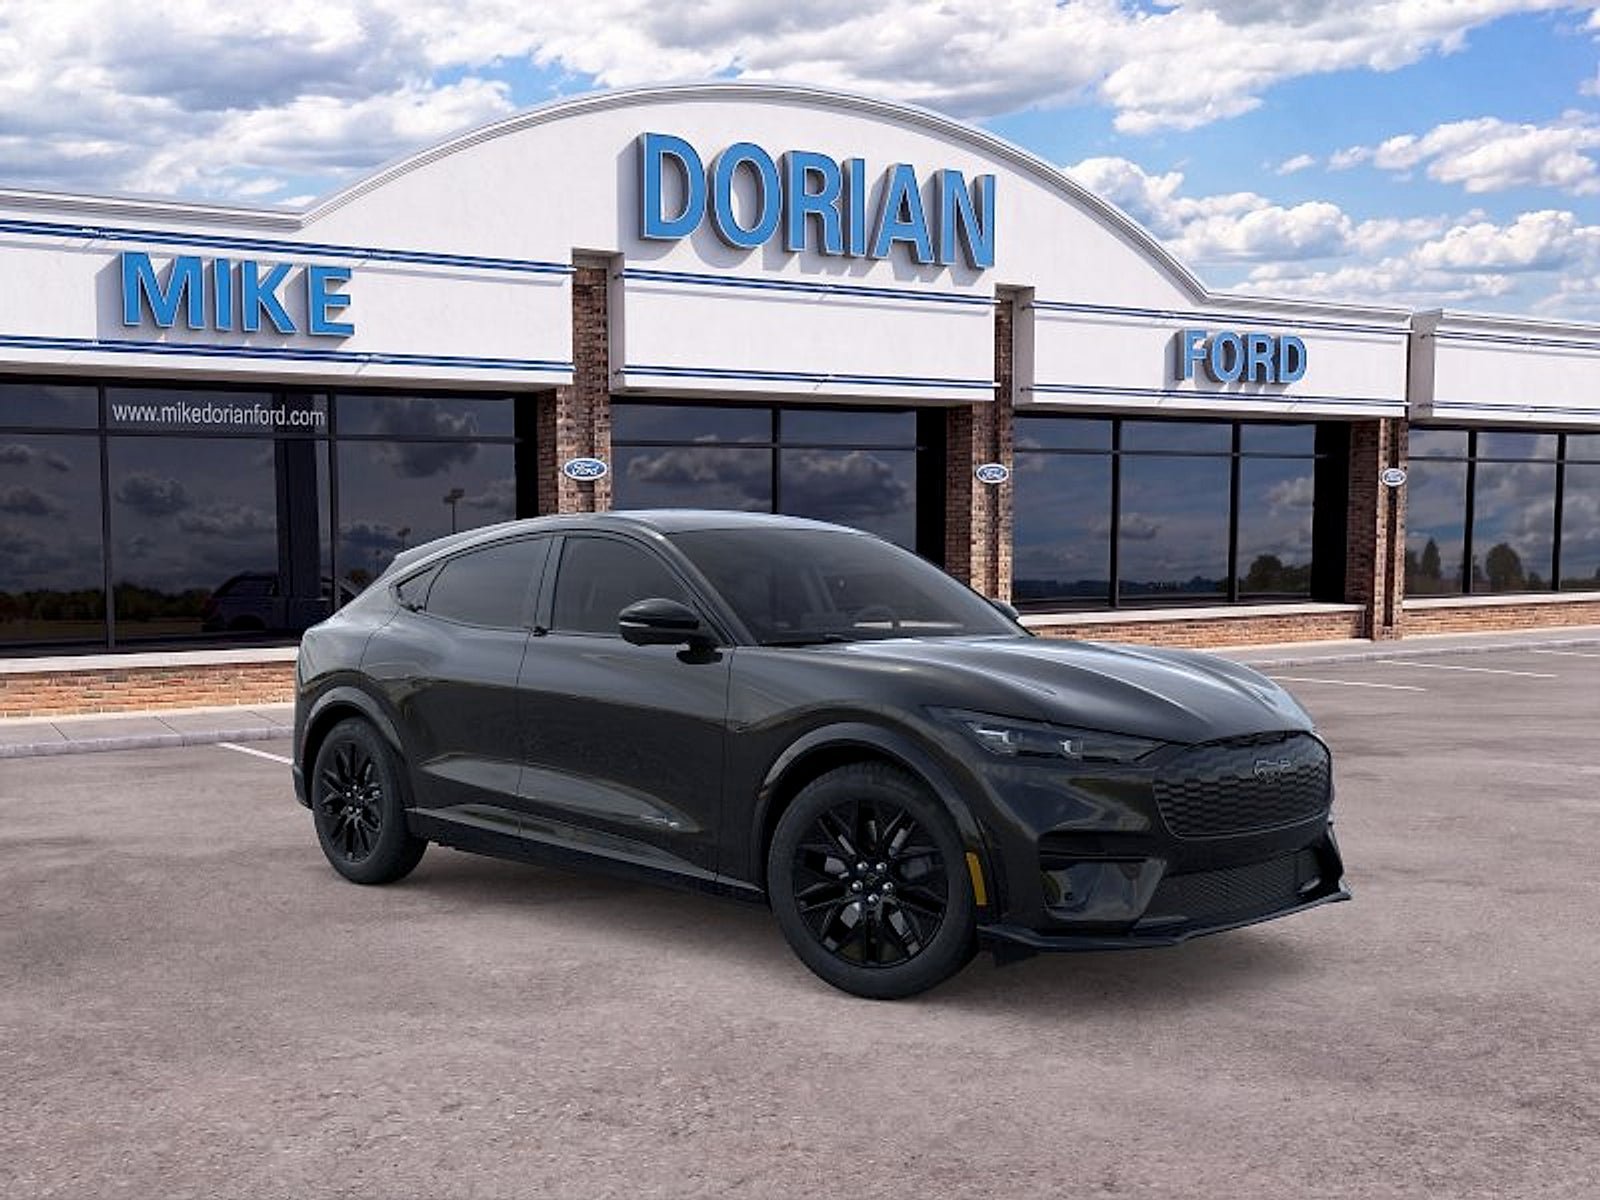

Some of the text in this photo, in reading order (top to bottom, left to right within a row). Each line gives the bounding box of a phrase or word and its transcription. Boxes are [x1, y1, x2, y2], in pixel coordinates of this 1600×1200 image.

[640, 132, 996, 270] DORIAN
[120, 251, 355, 337] MIKE
[1180, 327, 1308, 384] FORD
[112, 401, 326, 427] www.mikedorianford.com
